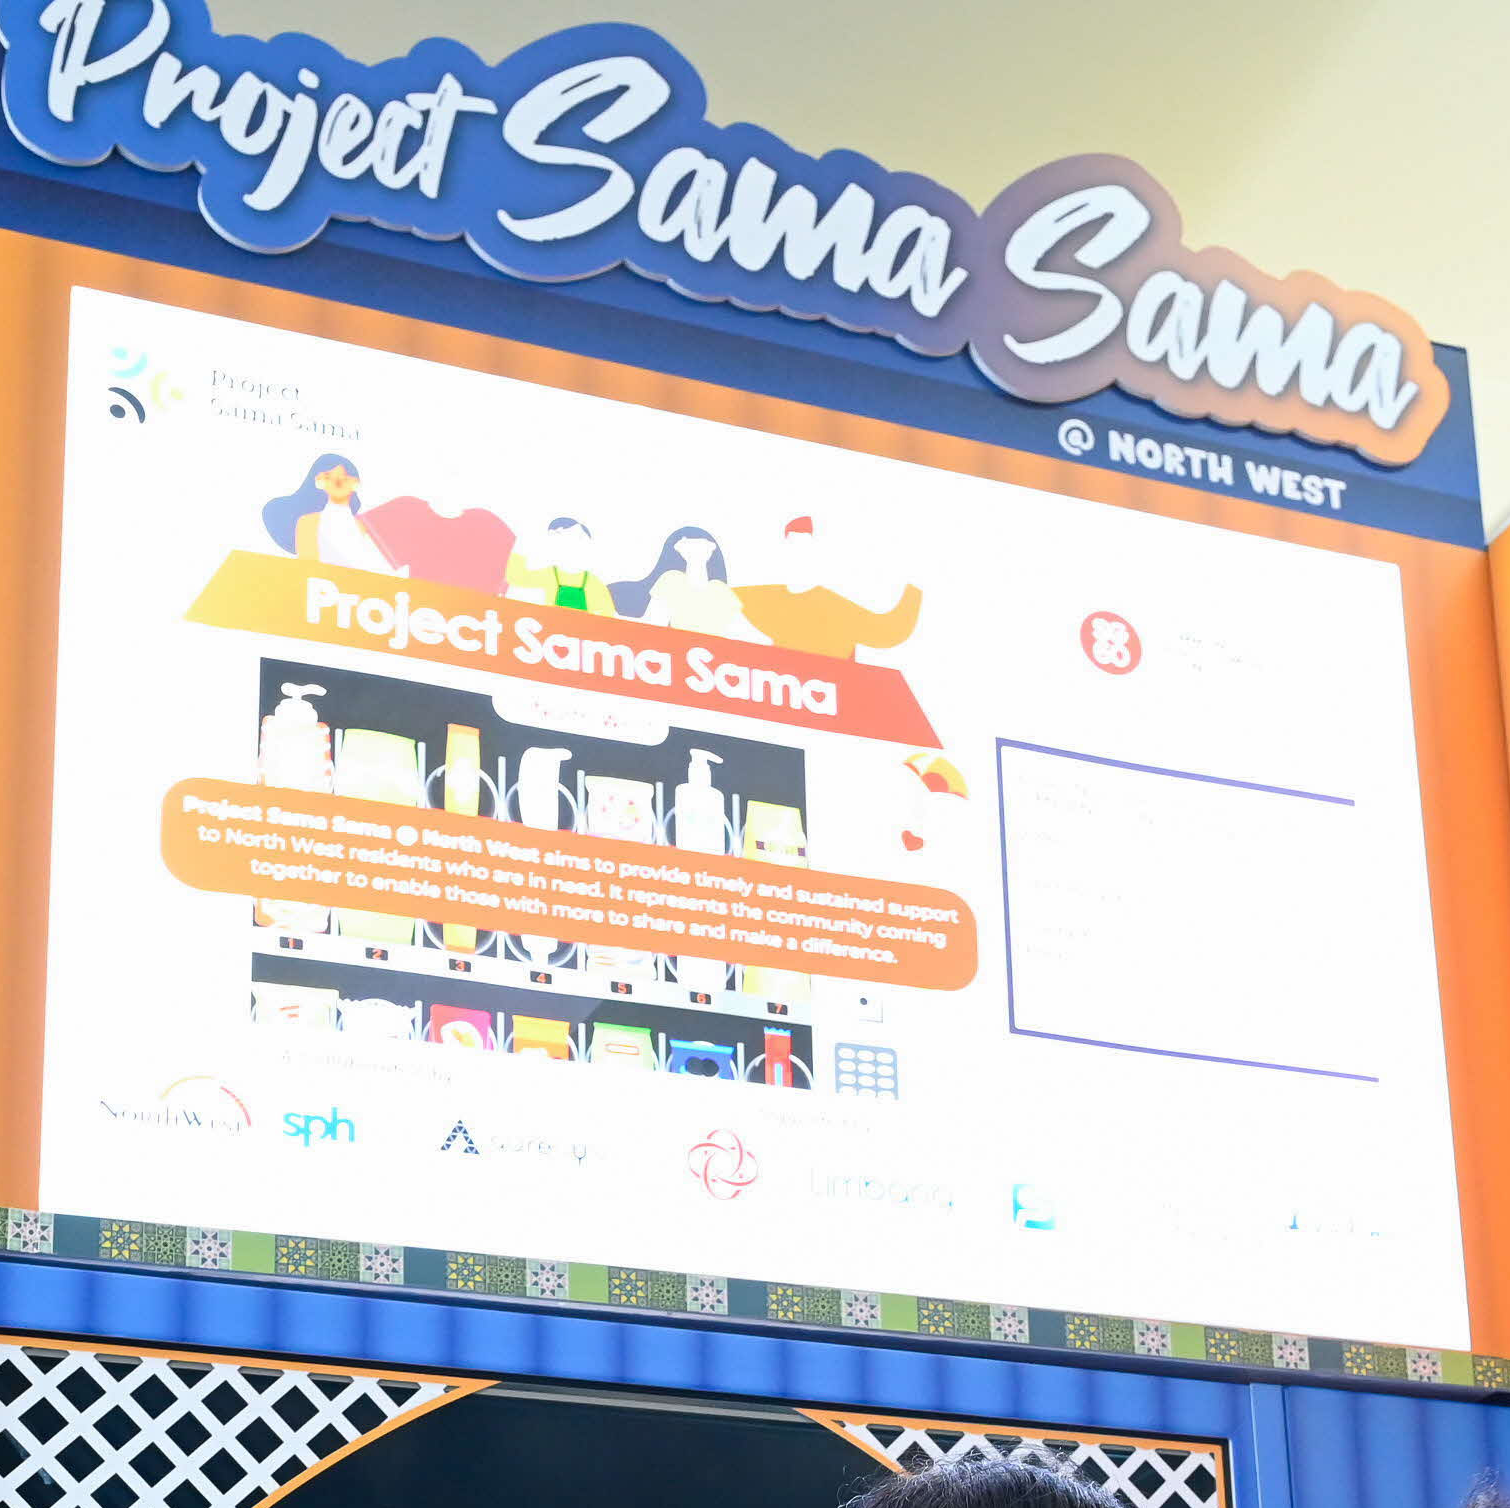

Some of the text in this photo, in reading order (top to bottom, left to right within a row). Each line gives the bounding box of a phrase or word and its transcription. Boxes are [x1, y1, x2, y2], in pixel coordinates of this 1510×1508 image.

[41, 0, 1423, 430] Project Sama Sama
[1057, 418, 1348, 510] @ NORTH WEST
[305, 577, 503, 656] Project
[512, 616, 672, 687] Sama
[684, 647, 840, 718] Sama
[181, 794, 960, 926] Project Sama Sama North West aims to provide timely and sustained support
[197, 824, 947, 950] to North West residents who are in need. It represents the community coming
[250, 858, 899, 965] together to enable those with more to share and make difference.
[282, 1106, 356, 1148] sph
